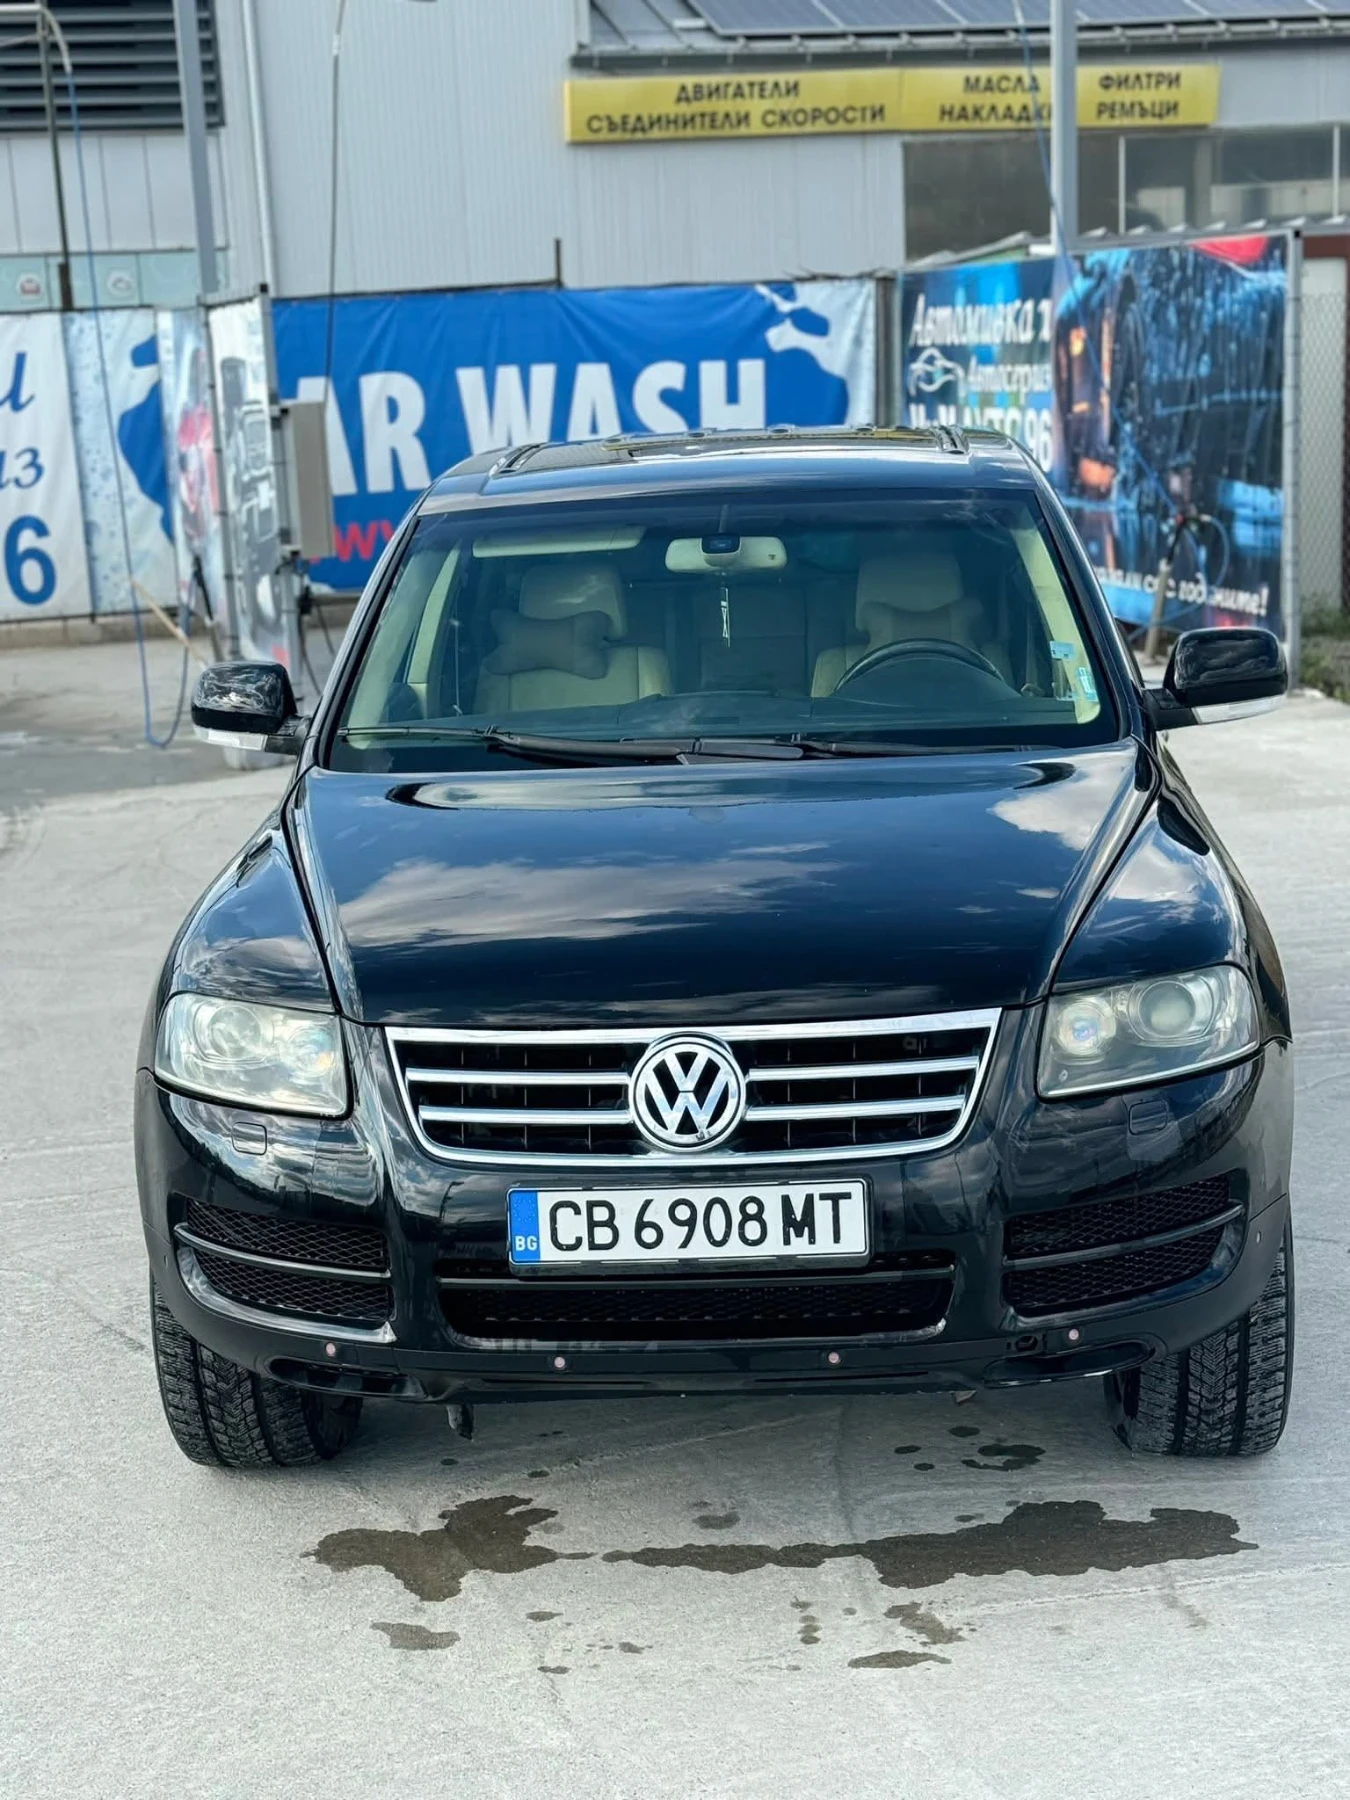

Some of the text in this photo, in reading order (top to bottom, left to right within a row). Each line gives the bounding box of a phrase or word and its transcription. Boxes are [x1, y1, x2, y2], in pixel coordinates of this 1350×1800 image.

[675, 80, 800, 105] ДВИГАТЕЛИ
[963, 73, 1041, 94] МАСЛА
[1098, 72, 1182, 92] ФИЛТРИ
[586, 104, 886, 135] СЪЕДИНИТЕЛИ СКОРОСТИ
[1096, 100, 1180, 121] РЕМЪЦИ
[456, 358, 767, 452] WASH
[549, 1192, 852, 1252] CB 6908 MT
[514, 1235, 538, 1251] BG
